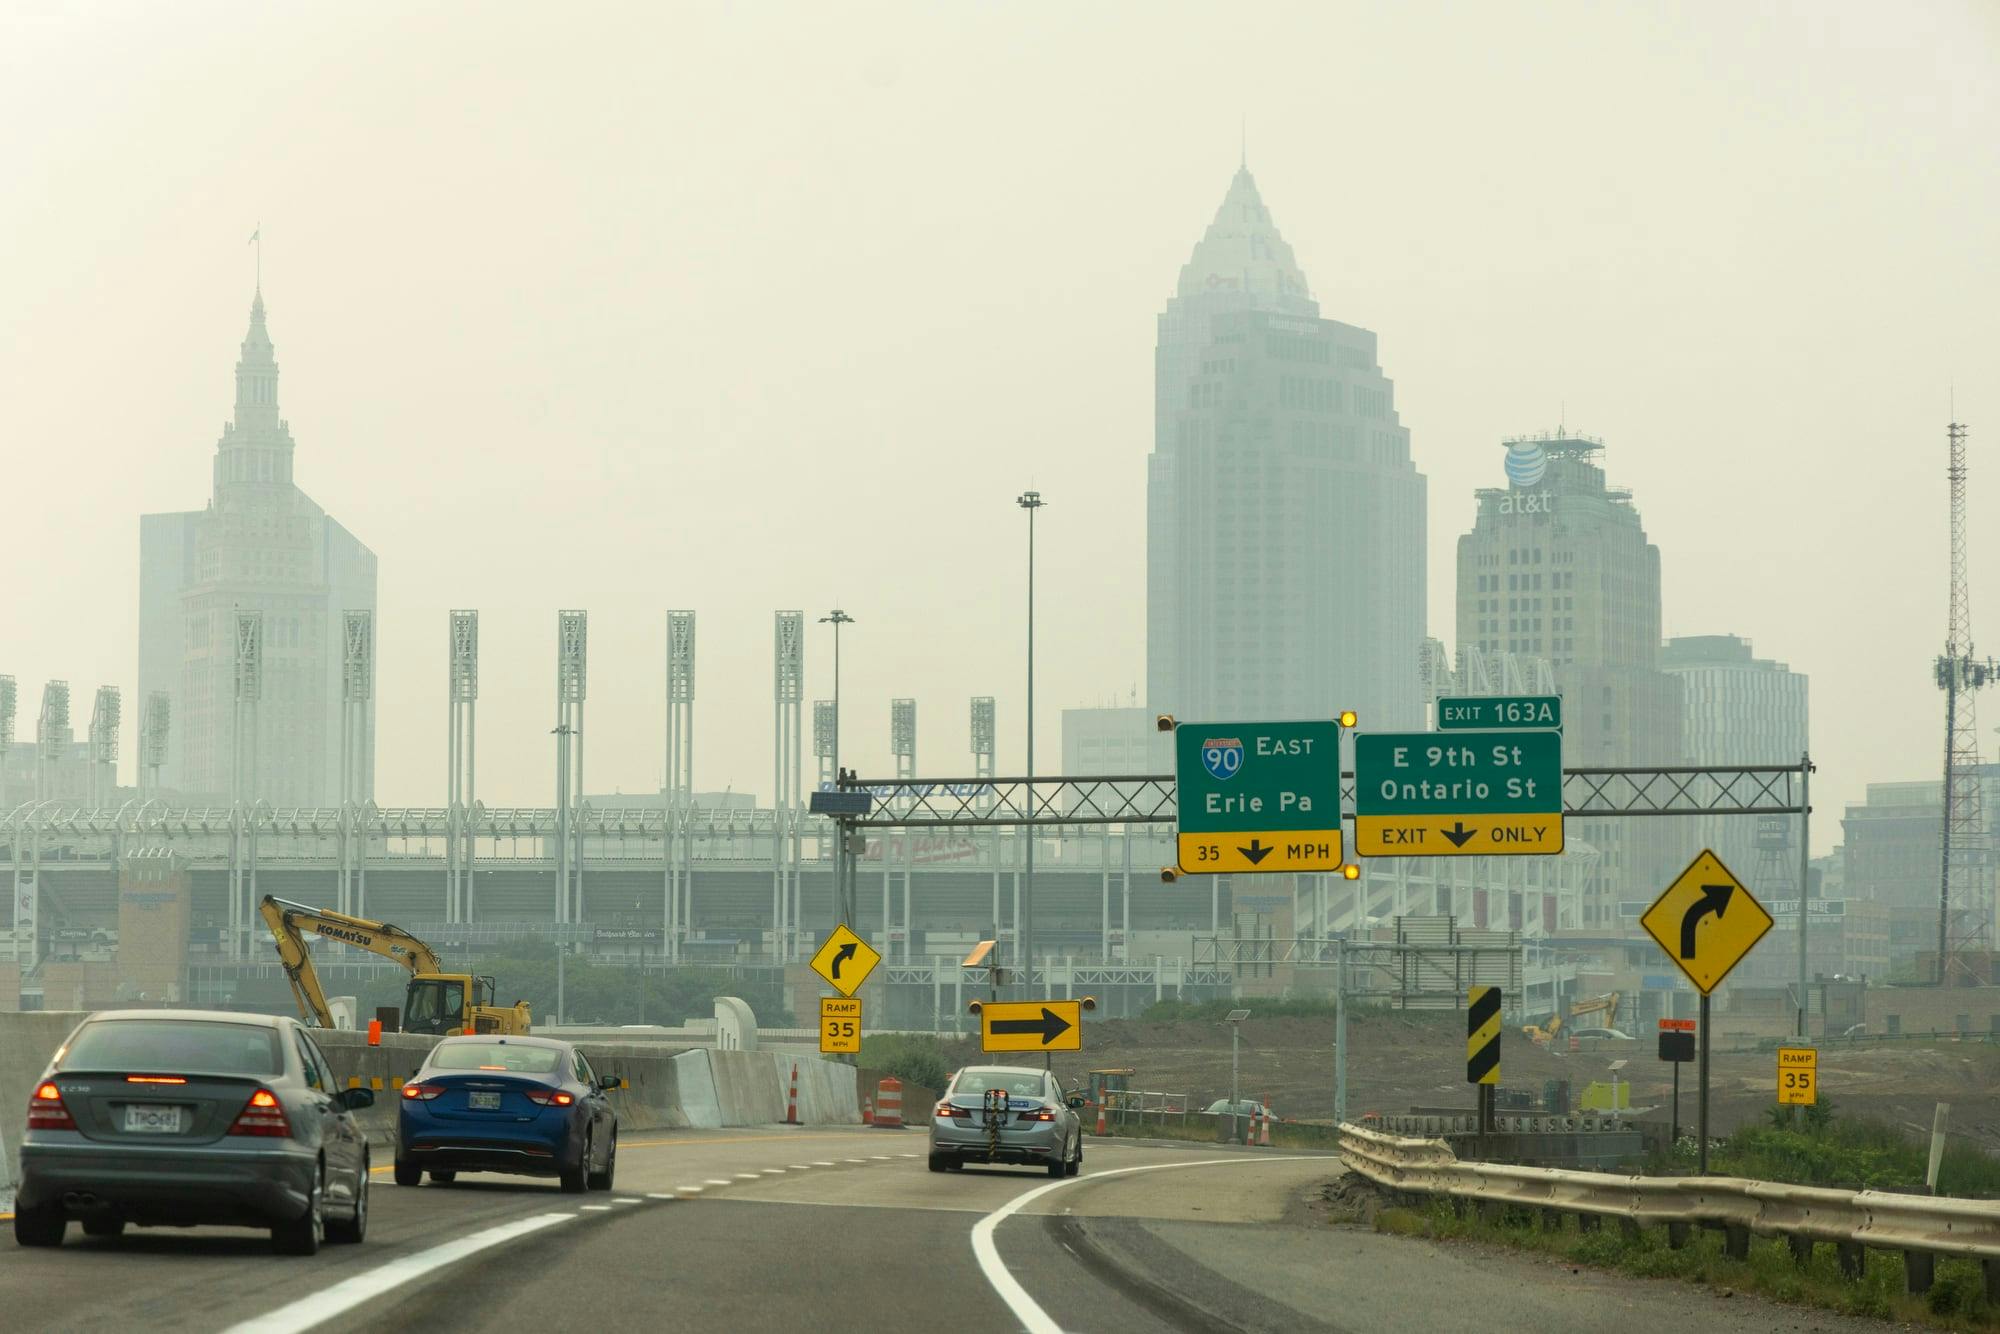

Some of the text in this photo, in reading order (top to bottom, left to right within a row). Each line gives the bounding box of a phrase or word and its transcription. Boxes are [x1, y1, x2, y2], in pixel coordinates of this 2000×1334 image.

[1499, 490, 1553, 514] at&t
[1445, 703, 1554, 723] EXIT 163A
[1256, 736, 1314, 756] EAST
[1206, 748, 1239, 772] 90
[1394, 746, 1523, 767] E 9th St
[1381, 778, 1537, 800] Ontario St
[1206, 792, 1313, 813] Erie Pa
[1382, 826, 1547, 845] EXIT ONLY
[1197, 843, 1331, 862] 35 MPH
[1805, 902, 1829, 913] OUSE
[316, 923, 372, 945] KOMATSU
[826, 1003, 856, 1012] RAMP
[828, 1022, 854, 1037] 35
[1783, 1054, 1812, 1063] RAMP
[1785, 1073, 1810, 1088] 35
